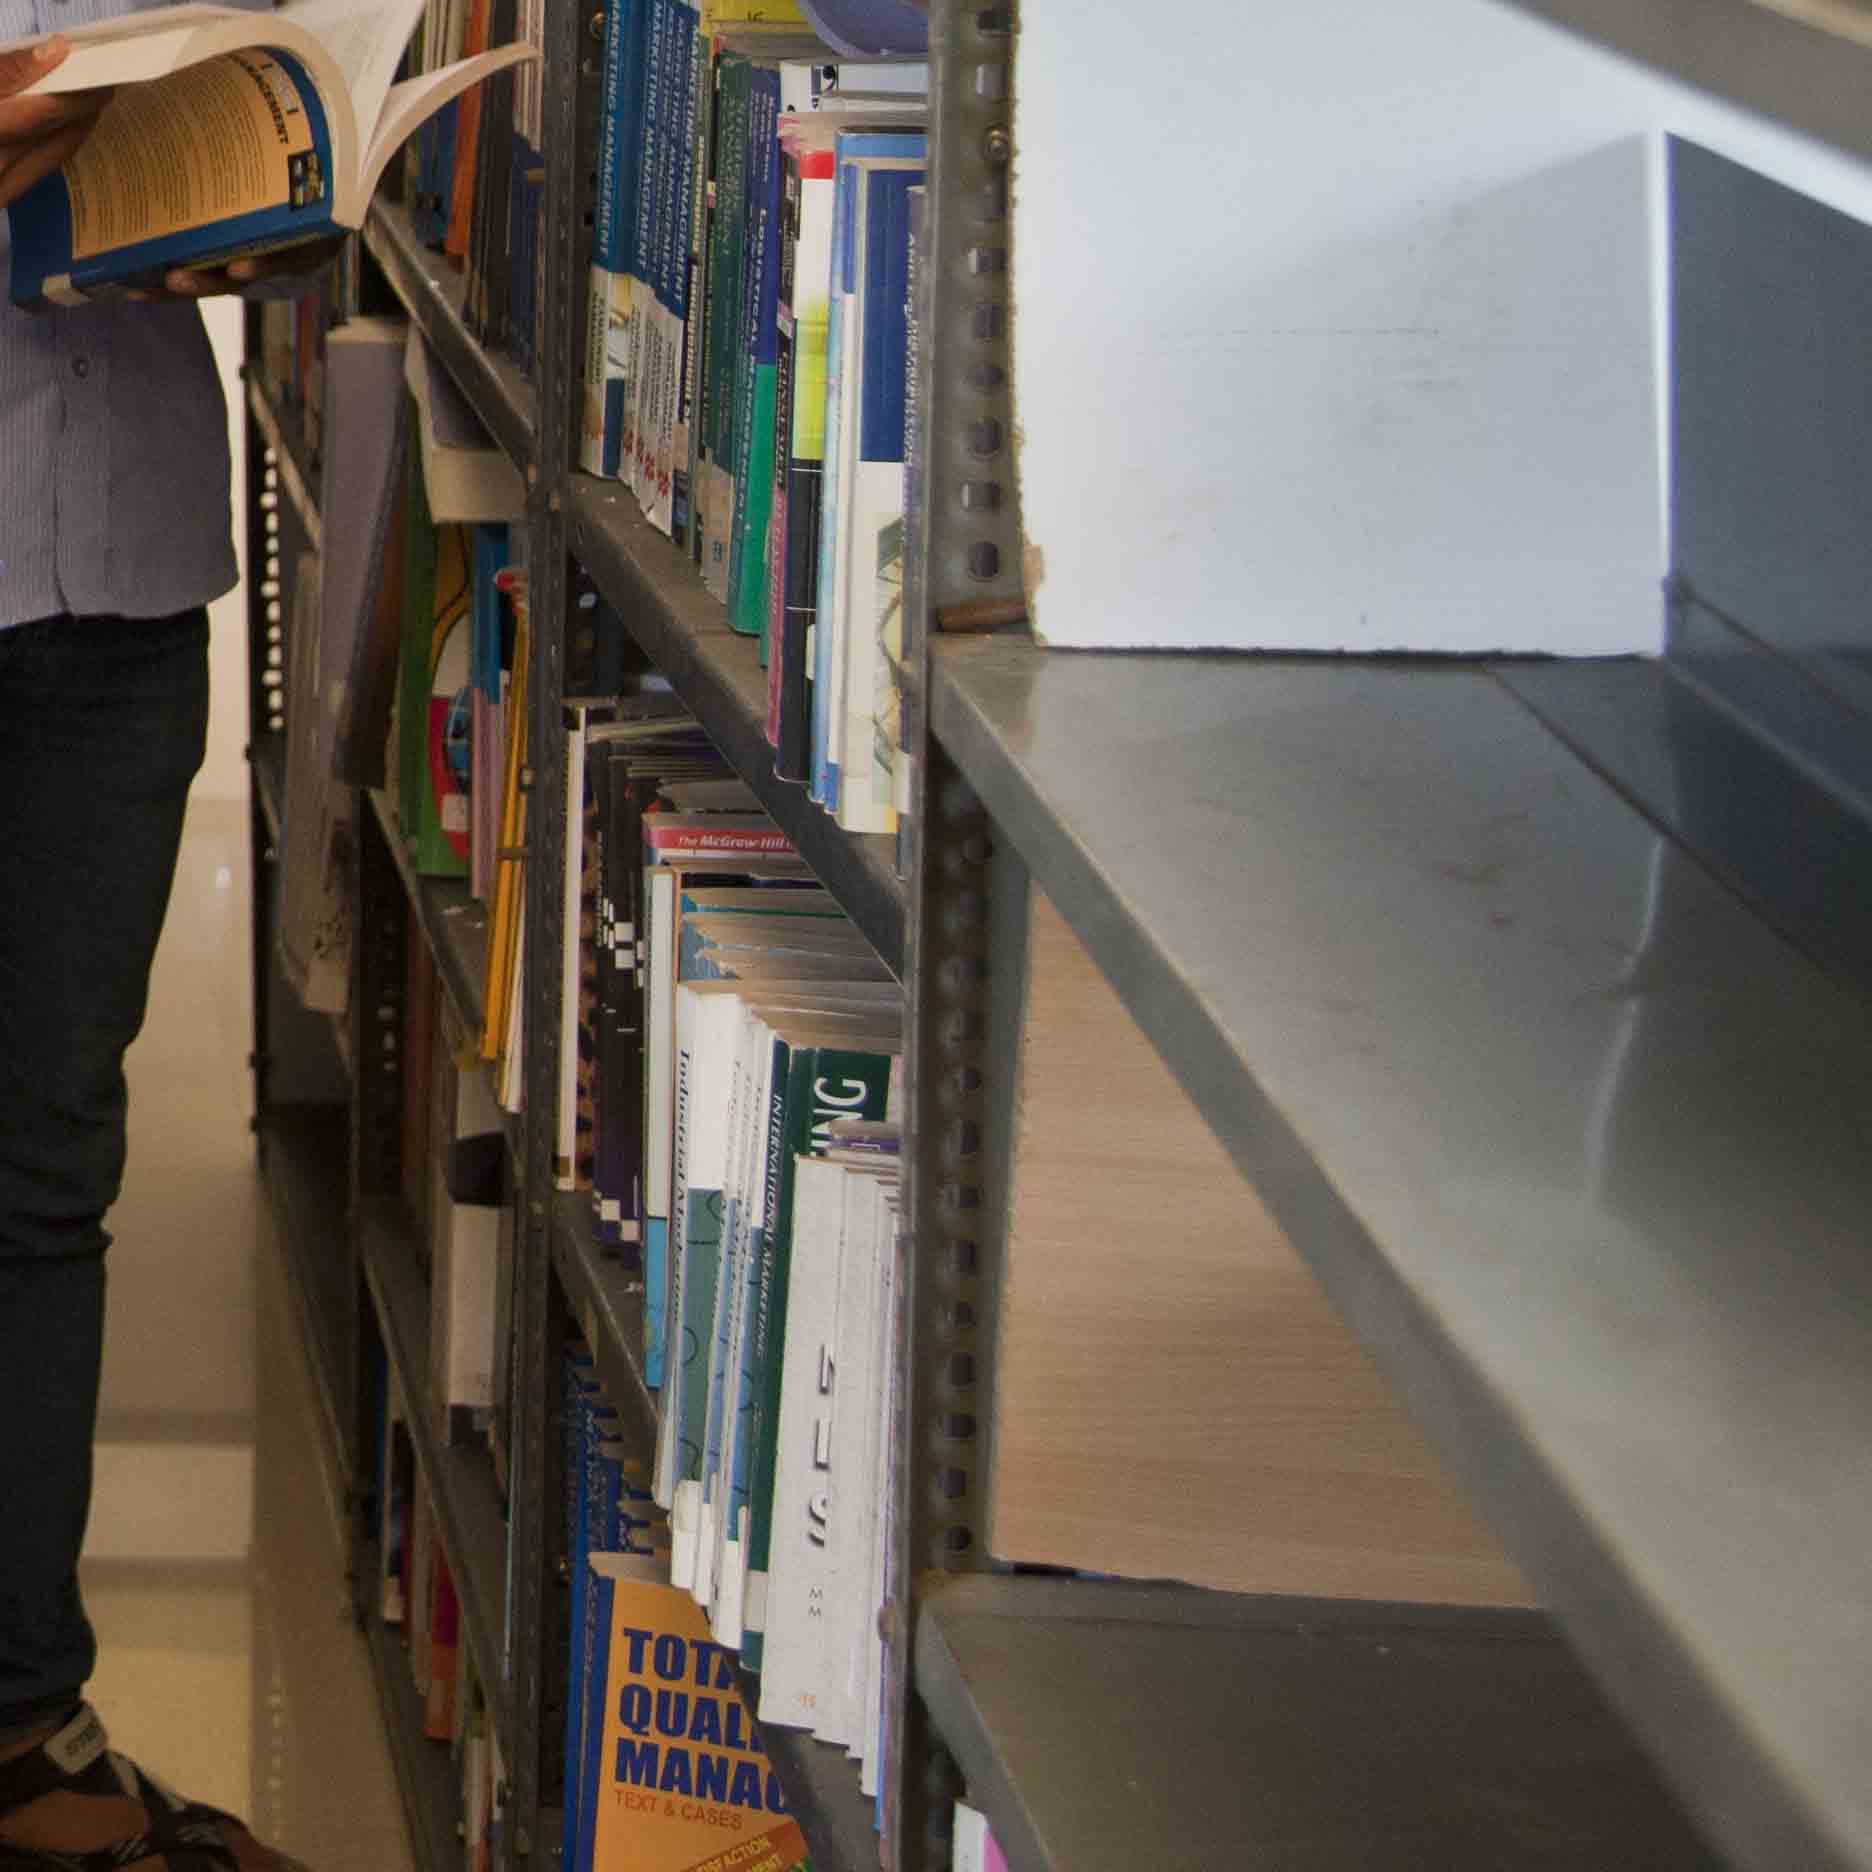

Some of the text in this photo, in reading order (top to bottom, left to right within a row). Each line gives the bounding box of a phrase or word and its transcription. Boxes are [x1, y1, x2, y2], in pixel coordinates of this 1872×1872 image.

[637, 0, 663, 271] MARKETING MANAGEMENT
[670, 13, 687, 137] MARKETING
[599, 115, 616, 258] MANAGEMENT
[673, 24, 700, 307] MARKETING MANAGEMENT
[737, 208, 768, 520] LOGISTICAL MANAGEMENT
[678, 835, 786, 850] The McGraw Hill
[675, 1046, 692, 1182] Industrial
[756, 1092, 784, 1360] INTERNATIONAL MARKETING
[615, 1789, 744, 1832] TEXT & CASES
